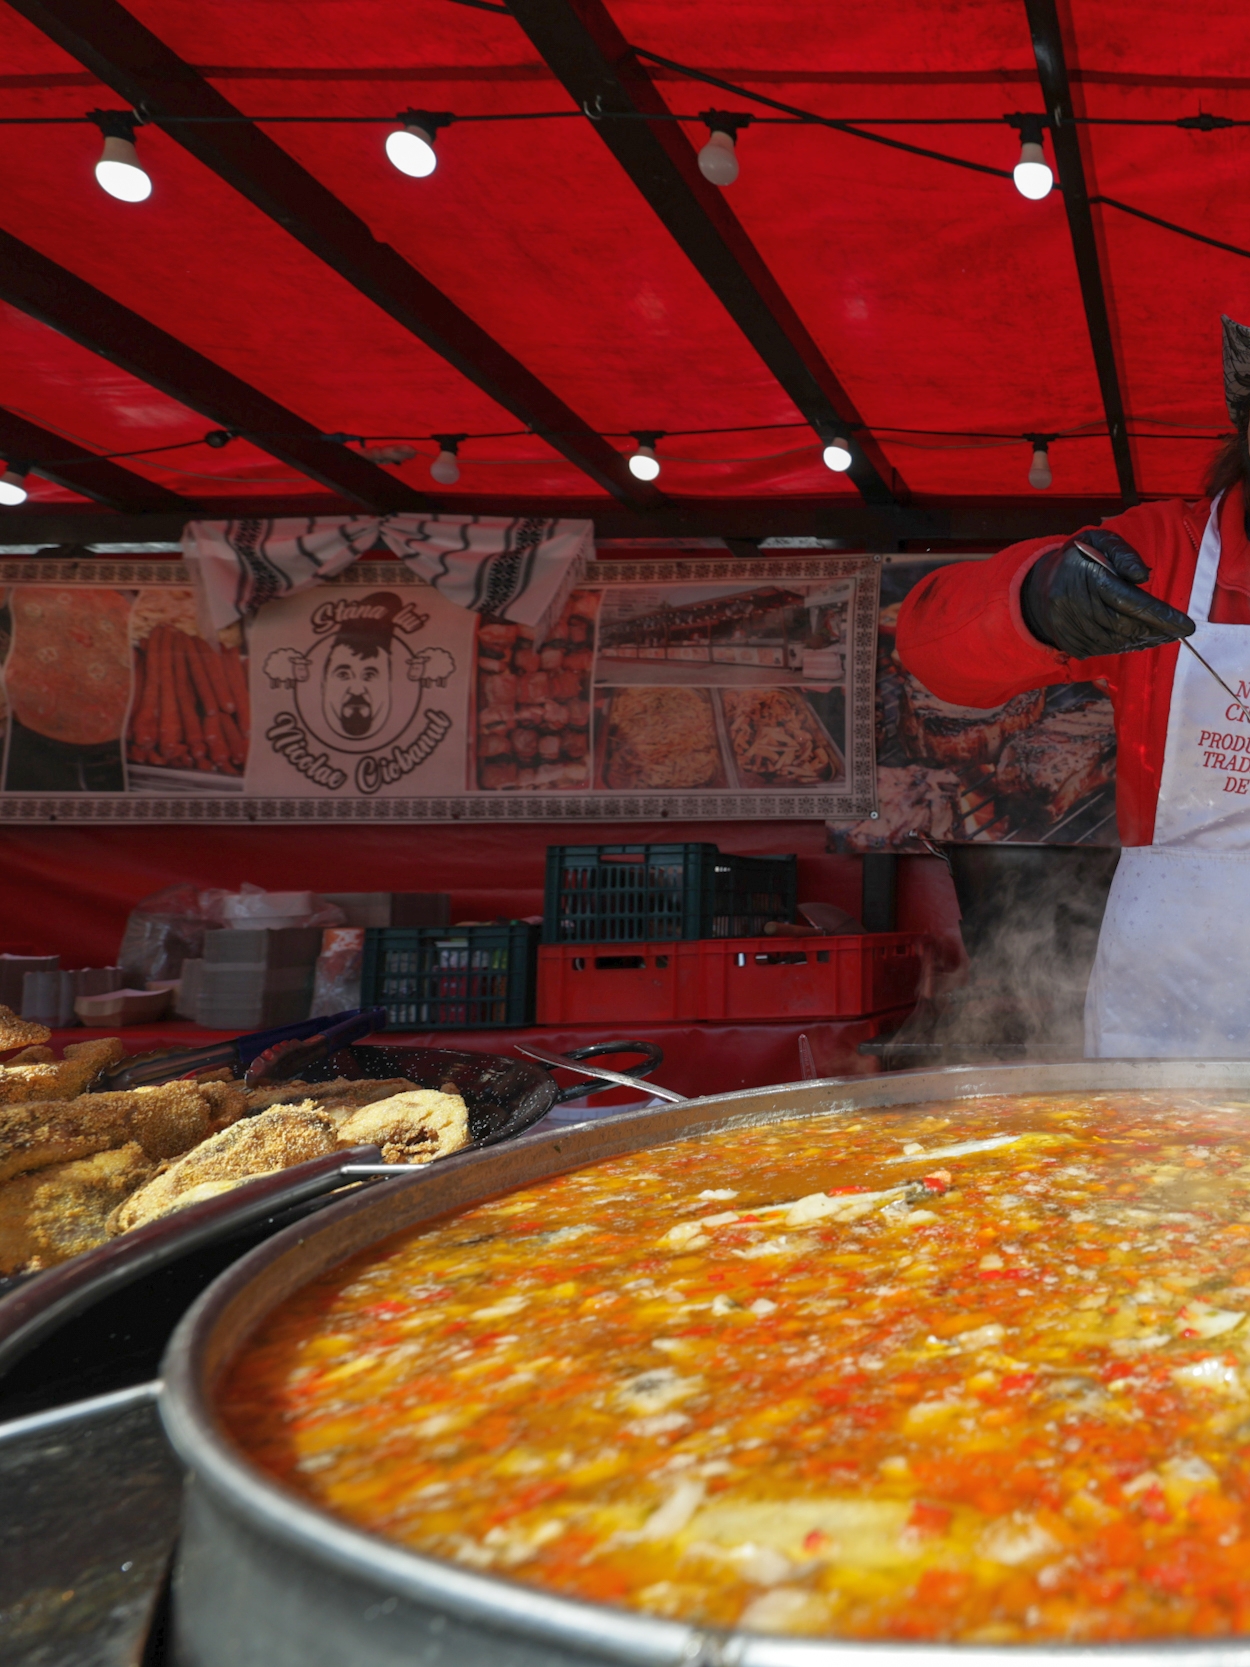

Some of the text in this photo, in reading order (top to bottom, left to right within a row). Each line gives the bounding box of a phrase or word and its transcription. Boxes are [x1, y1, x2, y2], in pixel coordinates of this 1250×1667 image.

[392, 602, 430, 634] lui
[265, 708, 452, 794] Nicolae Ciobanul
[1223, 776, 1250, 795] DE
